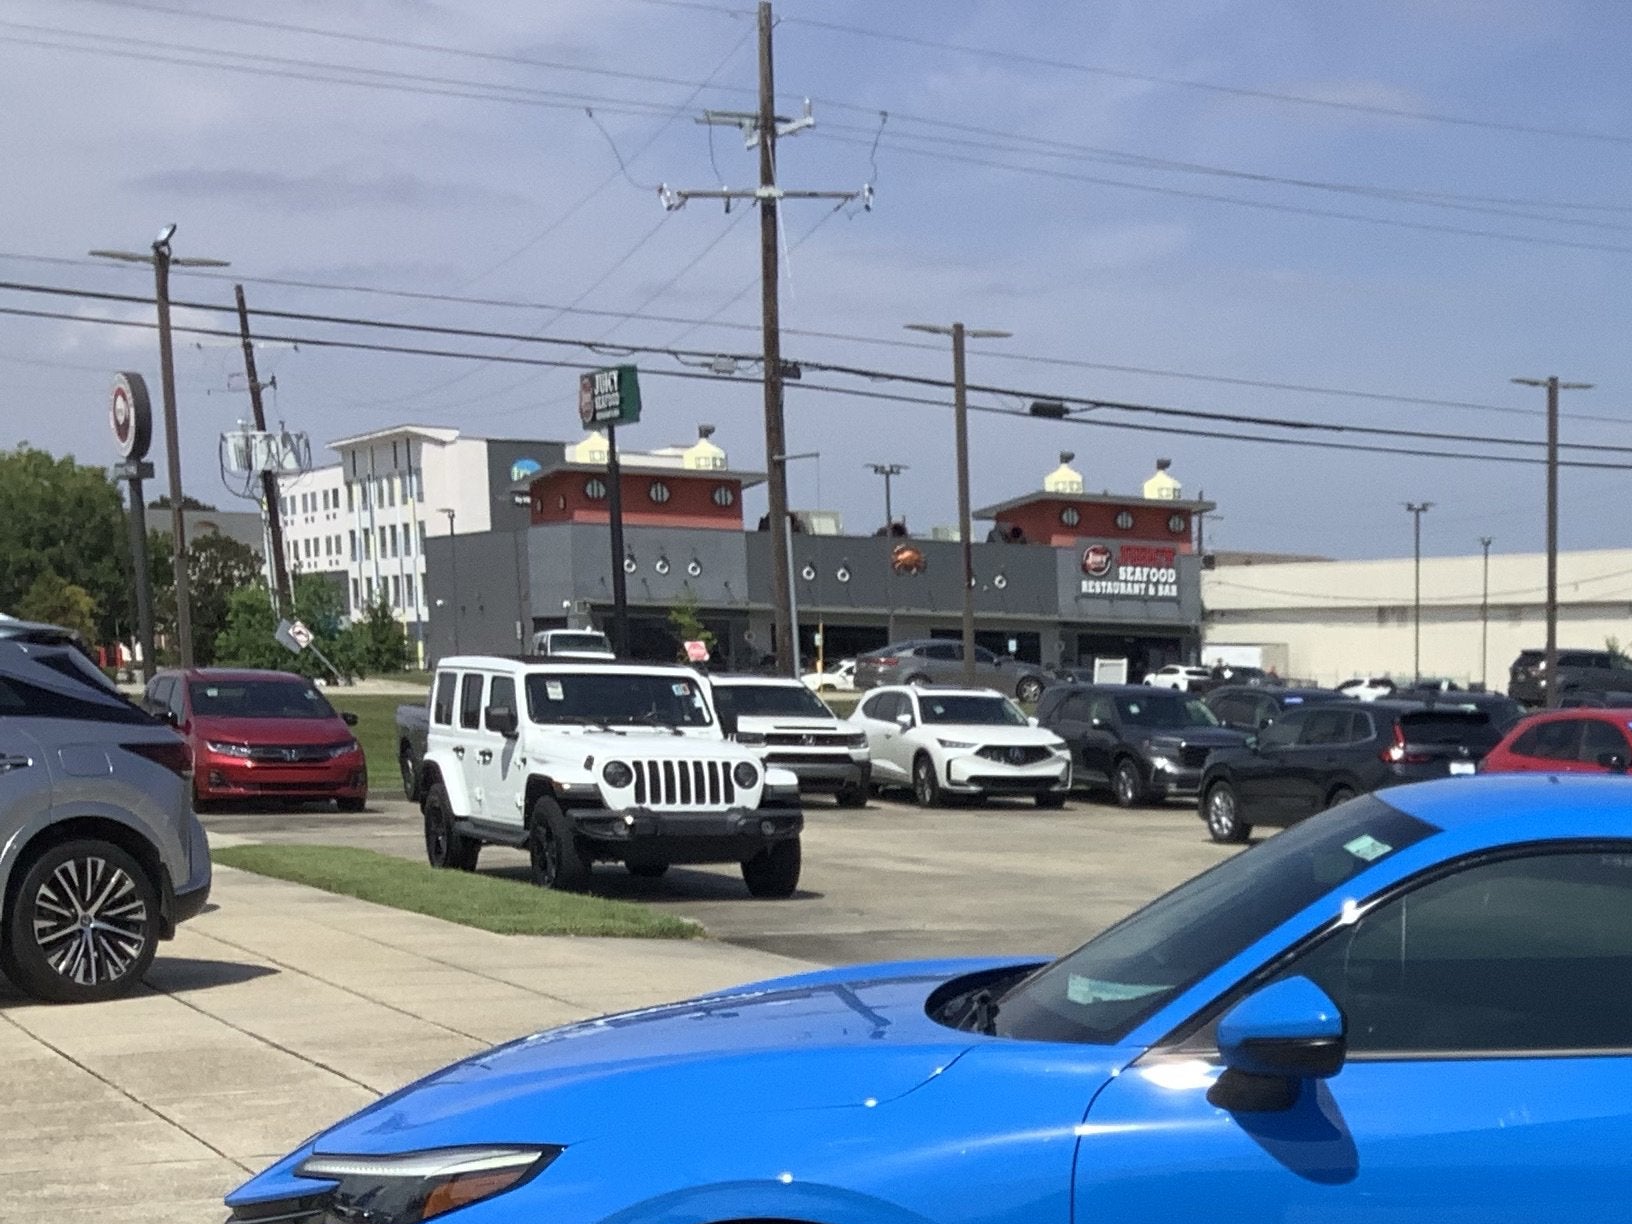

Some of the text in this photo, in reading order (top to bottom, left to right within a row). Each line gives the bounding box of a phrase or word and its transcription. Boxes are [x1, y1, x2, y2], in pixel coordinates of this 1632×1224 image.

[594, 370, 619, 395] JUICY
[1118, 566, 1176, 583] SEAFOOD
[1081, 580, 1146, 595] RESTAURANT
[1157, 585, 1177, 597] BAR
